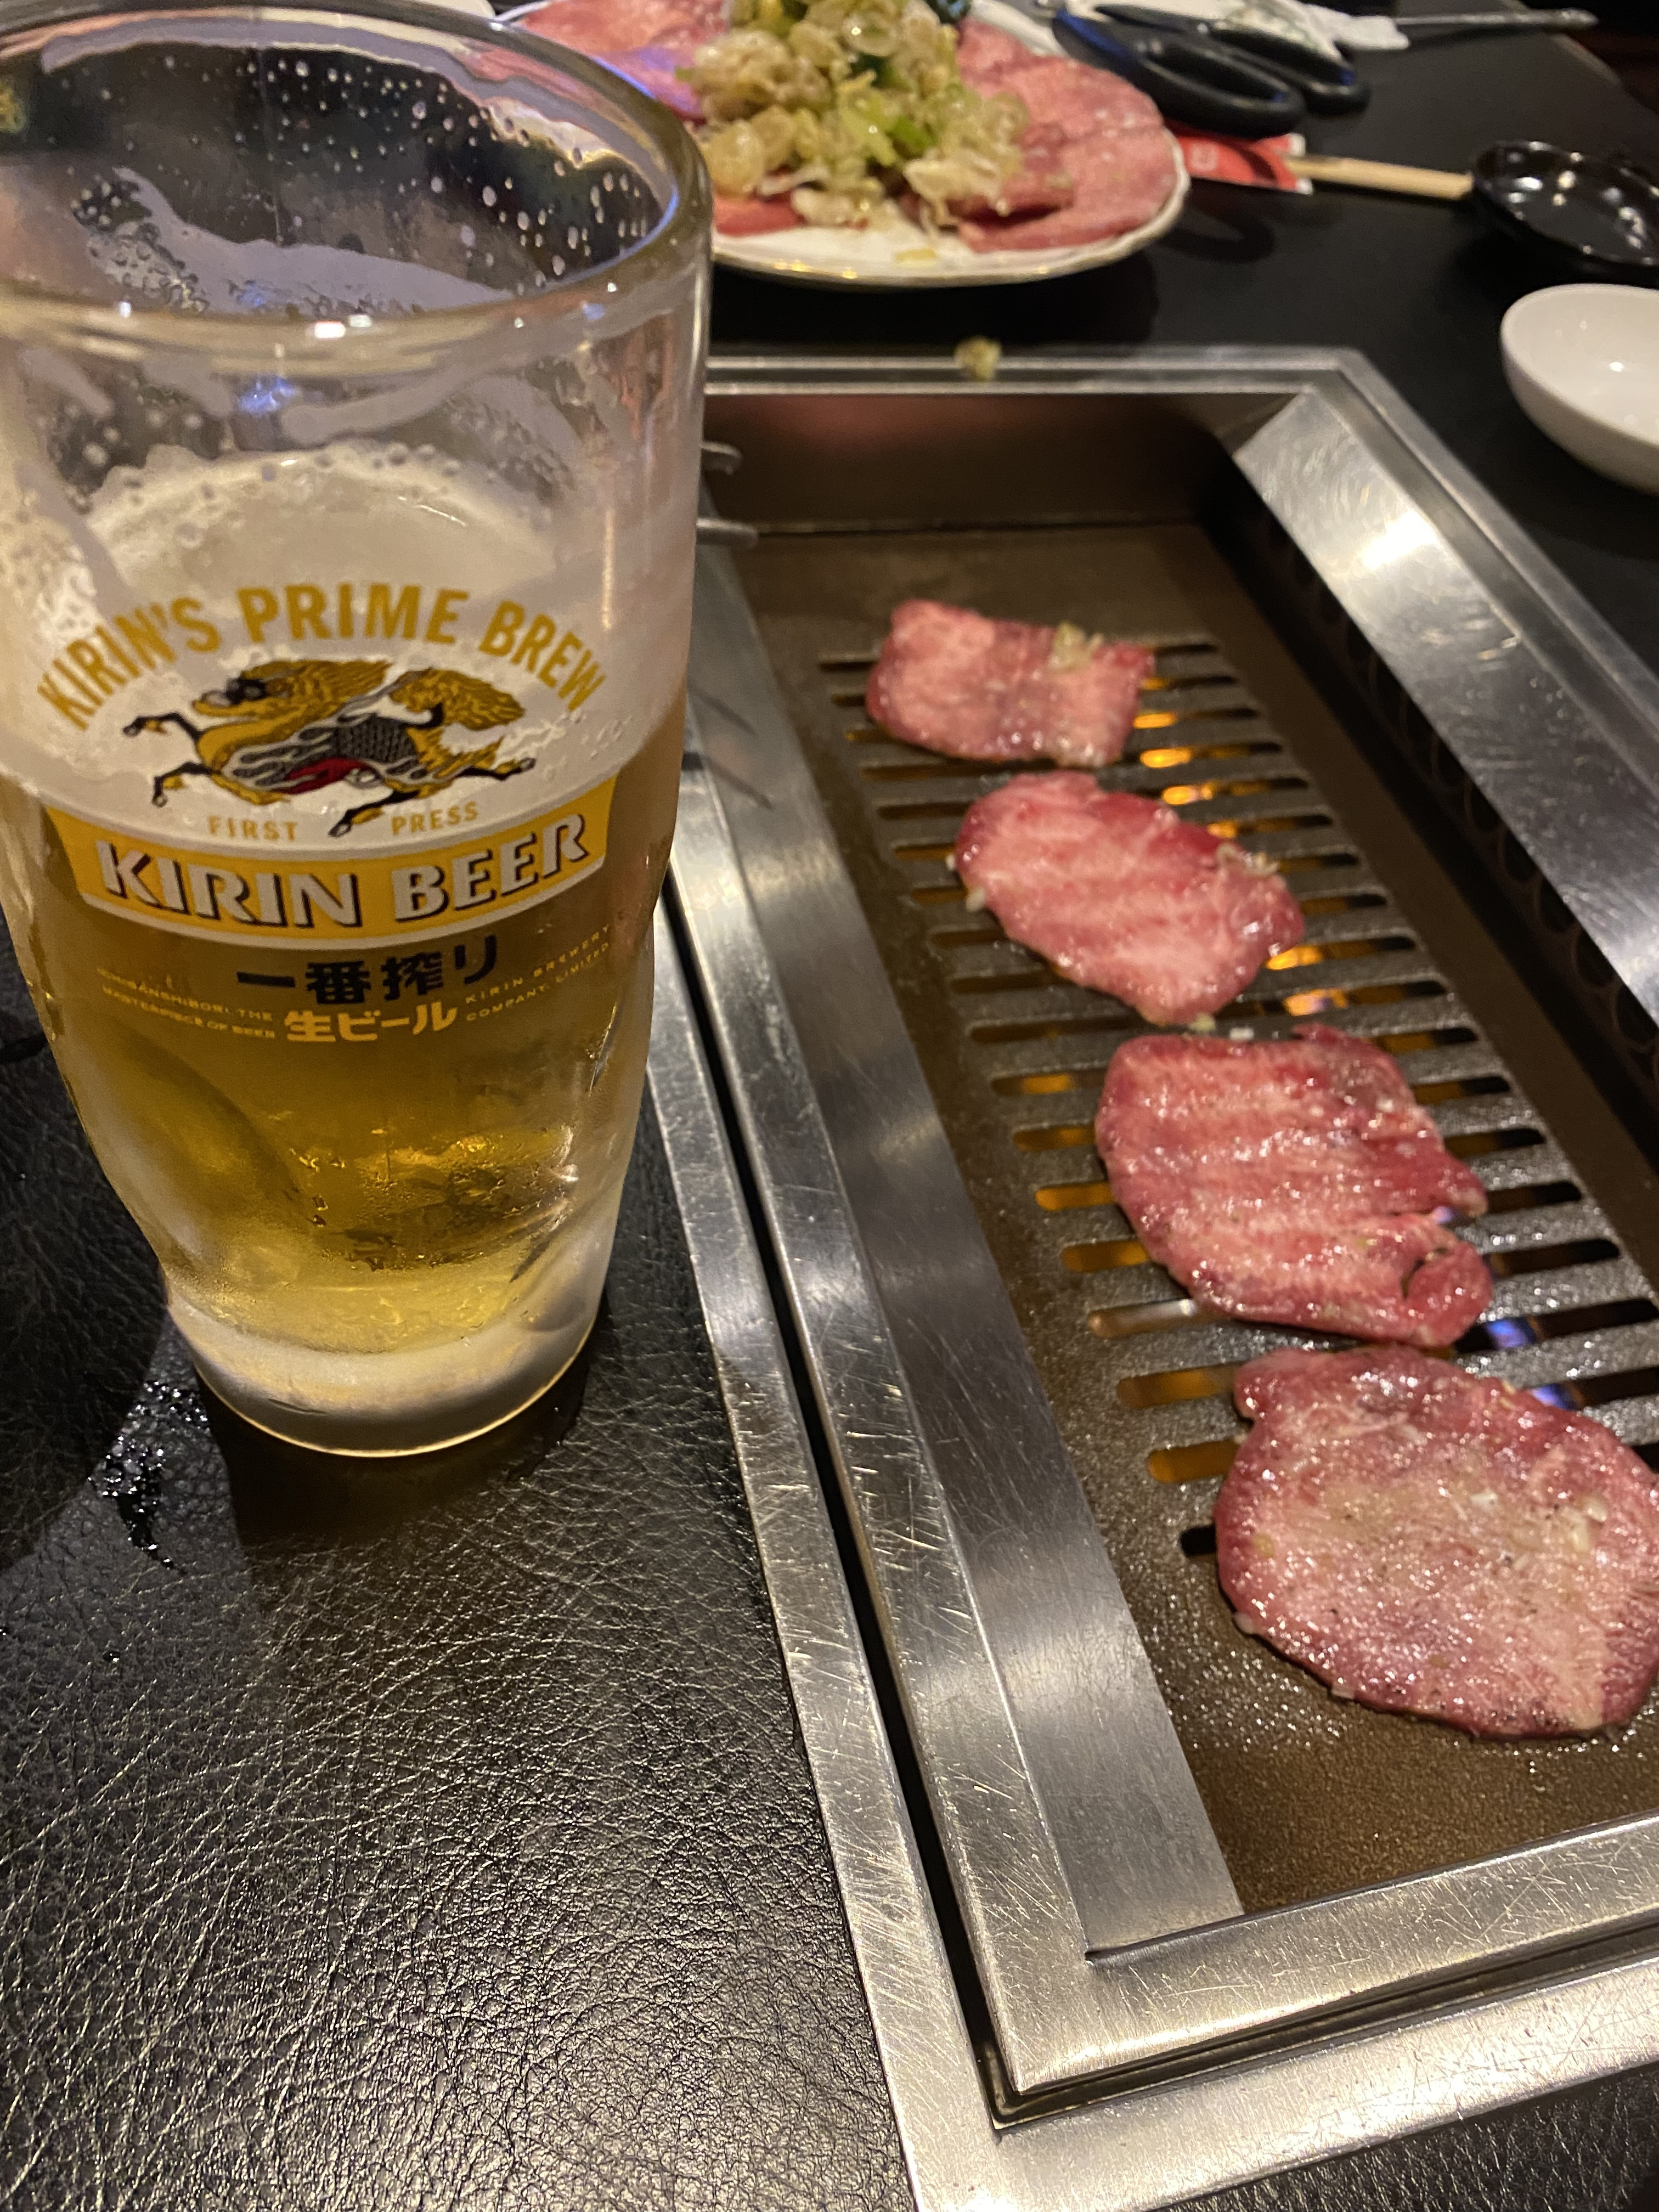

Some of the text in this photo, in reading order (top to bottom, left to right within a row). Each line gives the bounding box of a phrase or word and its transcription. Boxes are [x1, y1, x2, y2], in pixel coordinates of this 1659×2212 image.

[37, 581, 606, 731] KIRIN'S PRIME BREW
[207, 815, 297, 842] FIRST
[392, 802, 479, 835] PRESS
[95, 814, 589, 928] KIRIN BEER
[236, 934, 498, 1005] 一番搾り
[284, 1001, 458, 1042] 生ビール
